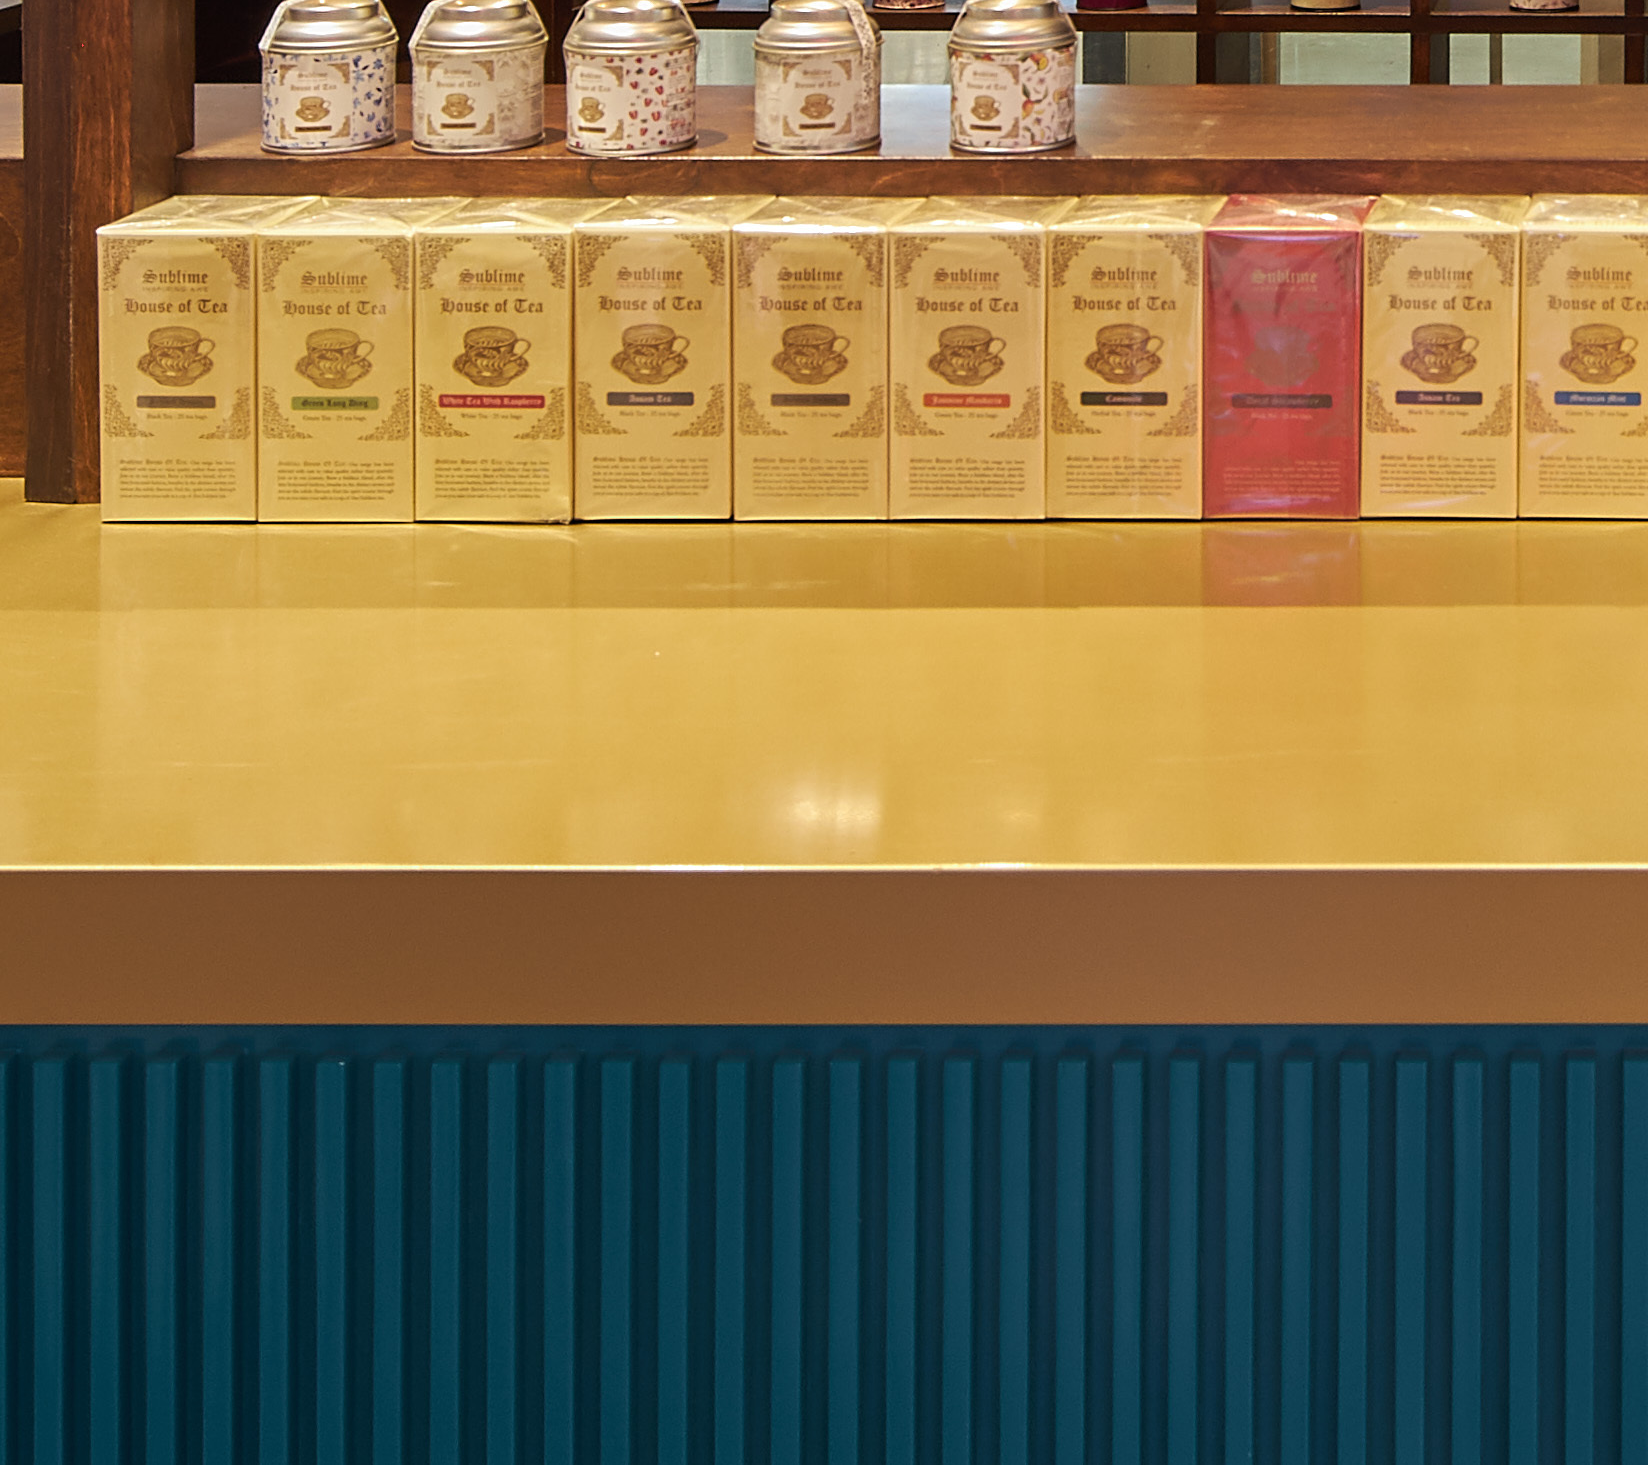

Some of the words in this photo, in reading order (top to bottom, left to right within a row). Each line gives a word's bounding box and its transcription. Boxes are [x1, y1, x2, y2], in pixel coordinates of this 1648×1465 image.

[141, 269, 209, 285] Sublime
[300, 271, 368, 287] Sublime
[458, 268, 526, 283] Sublime
[616, 266, 684, 281] Sublime
[776, 267, 844, 282] Sublime
[933, 267, 1001, 283] Sublime
[1090, 266, 1158, 281] Sublime
[1406, 265, 1474, 281] Sublime
[1565, 265, 1633, 281] Sublime
[123, 298, 172, 315] House
[178, 299, 192, 313] of
[198, 299, 228, 313] Tea
[282, 300, 331, 317] House
[337, 301, 351, 315] of
[356, 301, 387, 315] Tea
[440, 297, 489, 313] House
[495, 298, 509, 313] of
[514, 298, 545, 313] Tea
[598, 295, 647, 311] House
[653, 296, 667, 311] of
[672, 296, 703, 311] Tea
[758, 295, 807, 312] House
[813, 297, 827, 311] of
[832, 297, 863, 311] Tea
[915, 296, 964, 313] House
[970, 297, 984, 311] of
[990, 297, 1020, 311] Tea
[1072, 295, 1121, 311] House
[1127, 296, 1141, 311] of
[1146, 296, 1177, 311] Tea
[1388, 295, 1437, 311] House
[1443, 295, 1457, 310] of
[1462, 295, 1493, 310] Tea
[1547, 295, 1596, 311] House
[1602, 295, 1616, 310] of
